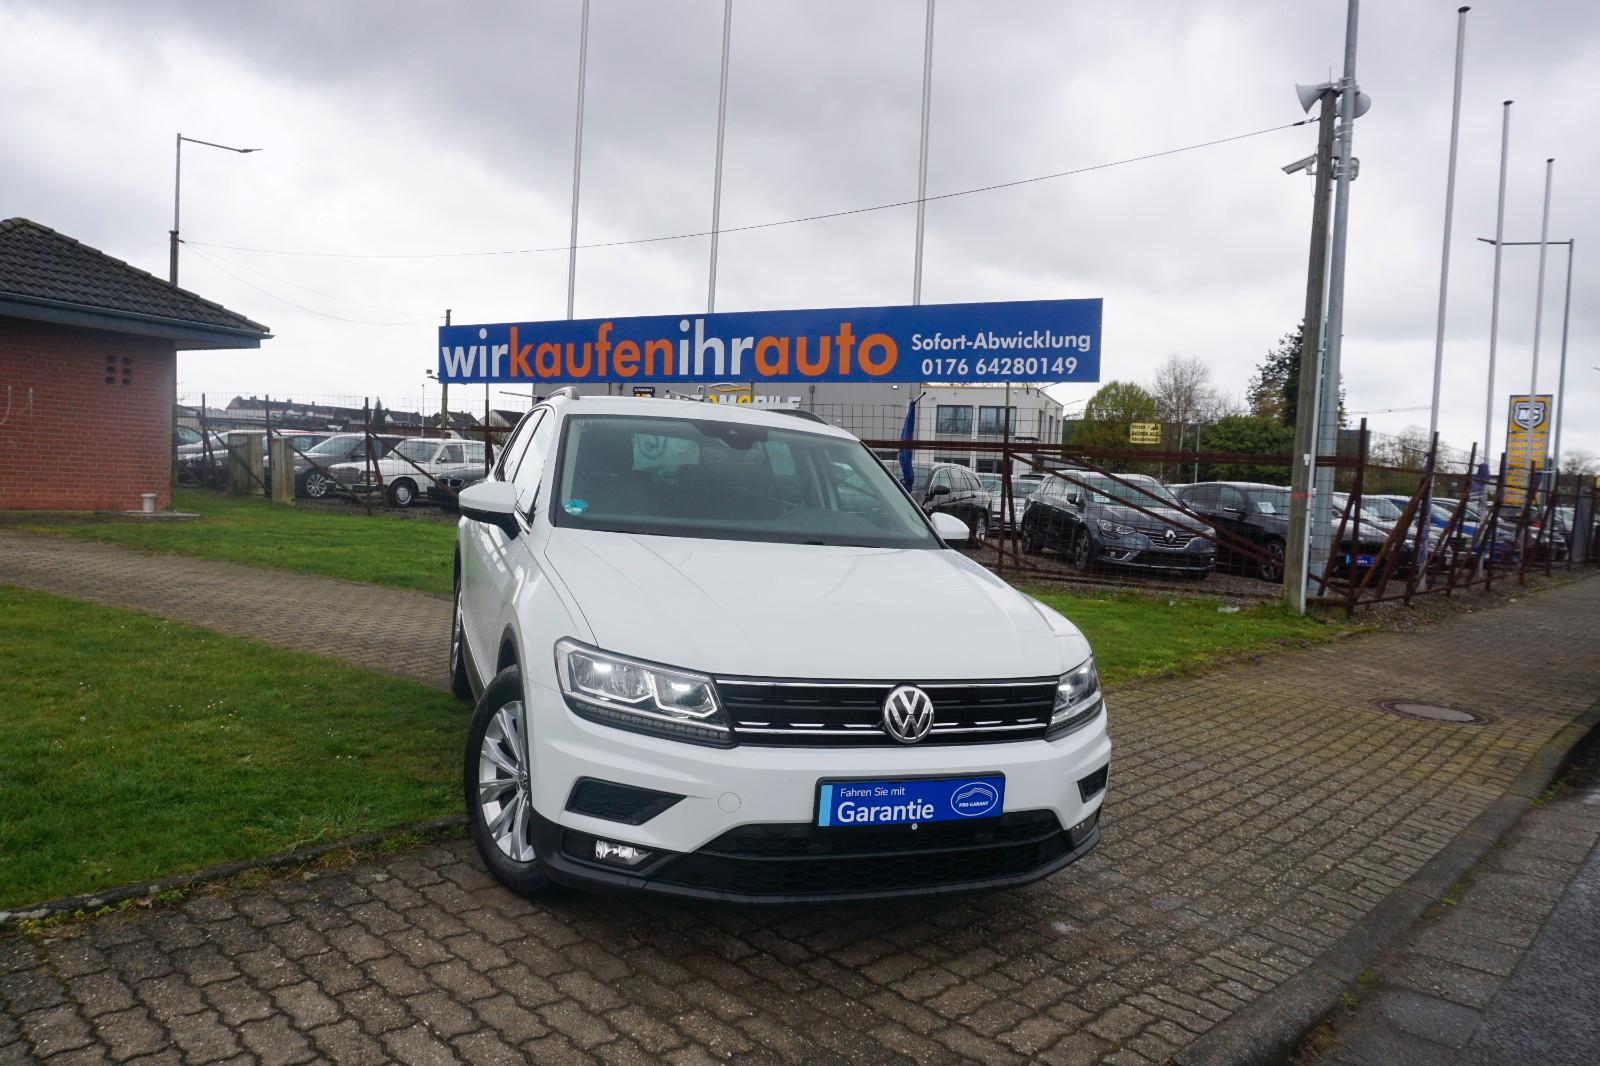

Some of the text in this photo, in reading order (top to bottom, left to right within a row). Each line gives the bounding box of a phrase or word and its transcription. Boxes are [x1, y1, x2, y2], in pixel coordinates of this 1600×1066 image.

[442, 319, 898, 377] wirkaufenihrauto
[911, 331, 1091, 352] Sofort-Abwicklung
[921, 357, 1078, 375] 0176 64280149
[840, 786, 906, 797] Fahren Sie mit
[837, 798, 935, 823] Garantie
